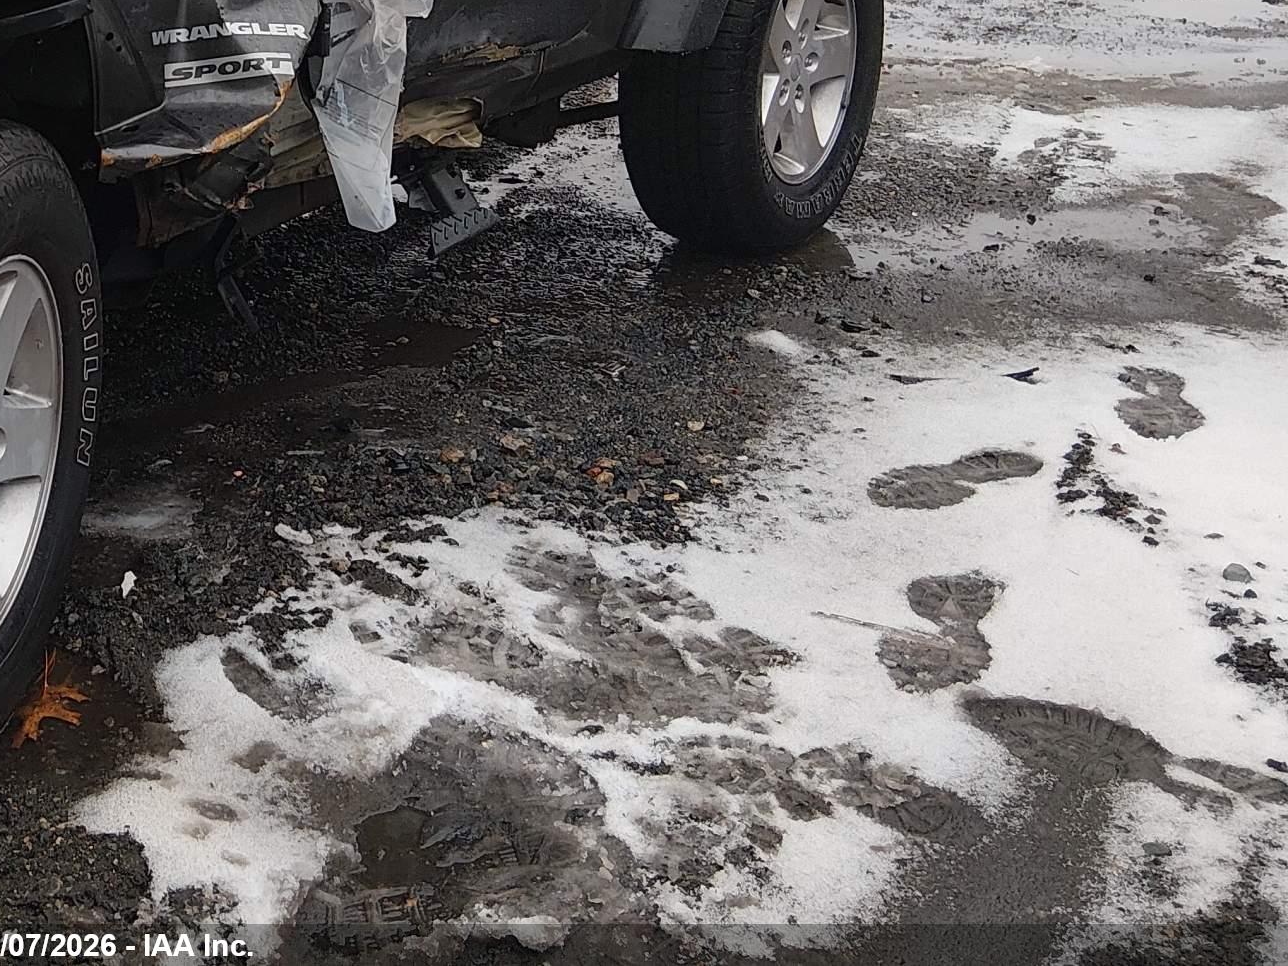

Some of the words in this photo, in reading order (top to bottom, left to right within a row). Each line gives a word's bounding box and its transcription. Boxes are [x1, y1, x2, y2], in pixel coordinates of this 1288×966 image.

[151, 21, 311, 46] WRANGLER
[171, 57, 284, 81] SPORT
[75, 262, 100, 467] SAILUN
